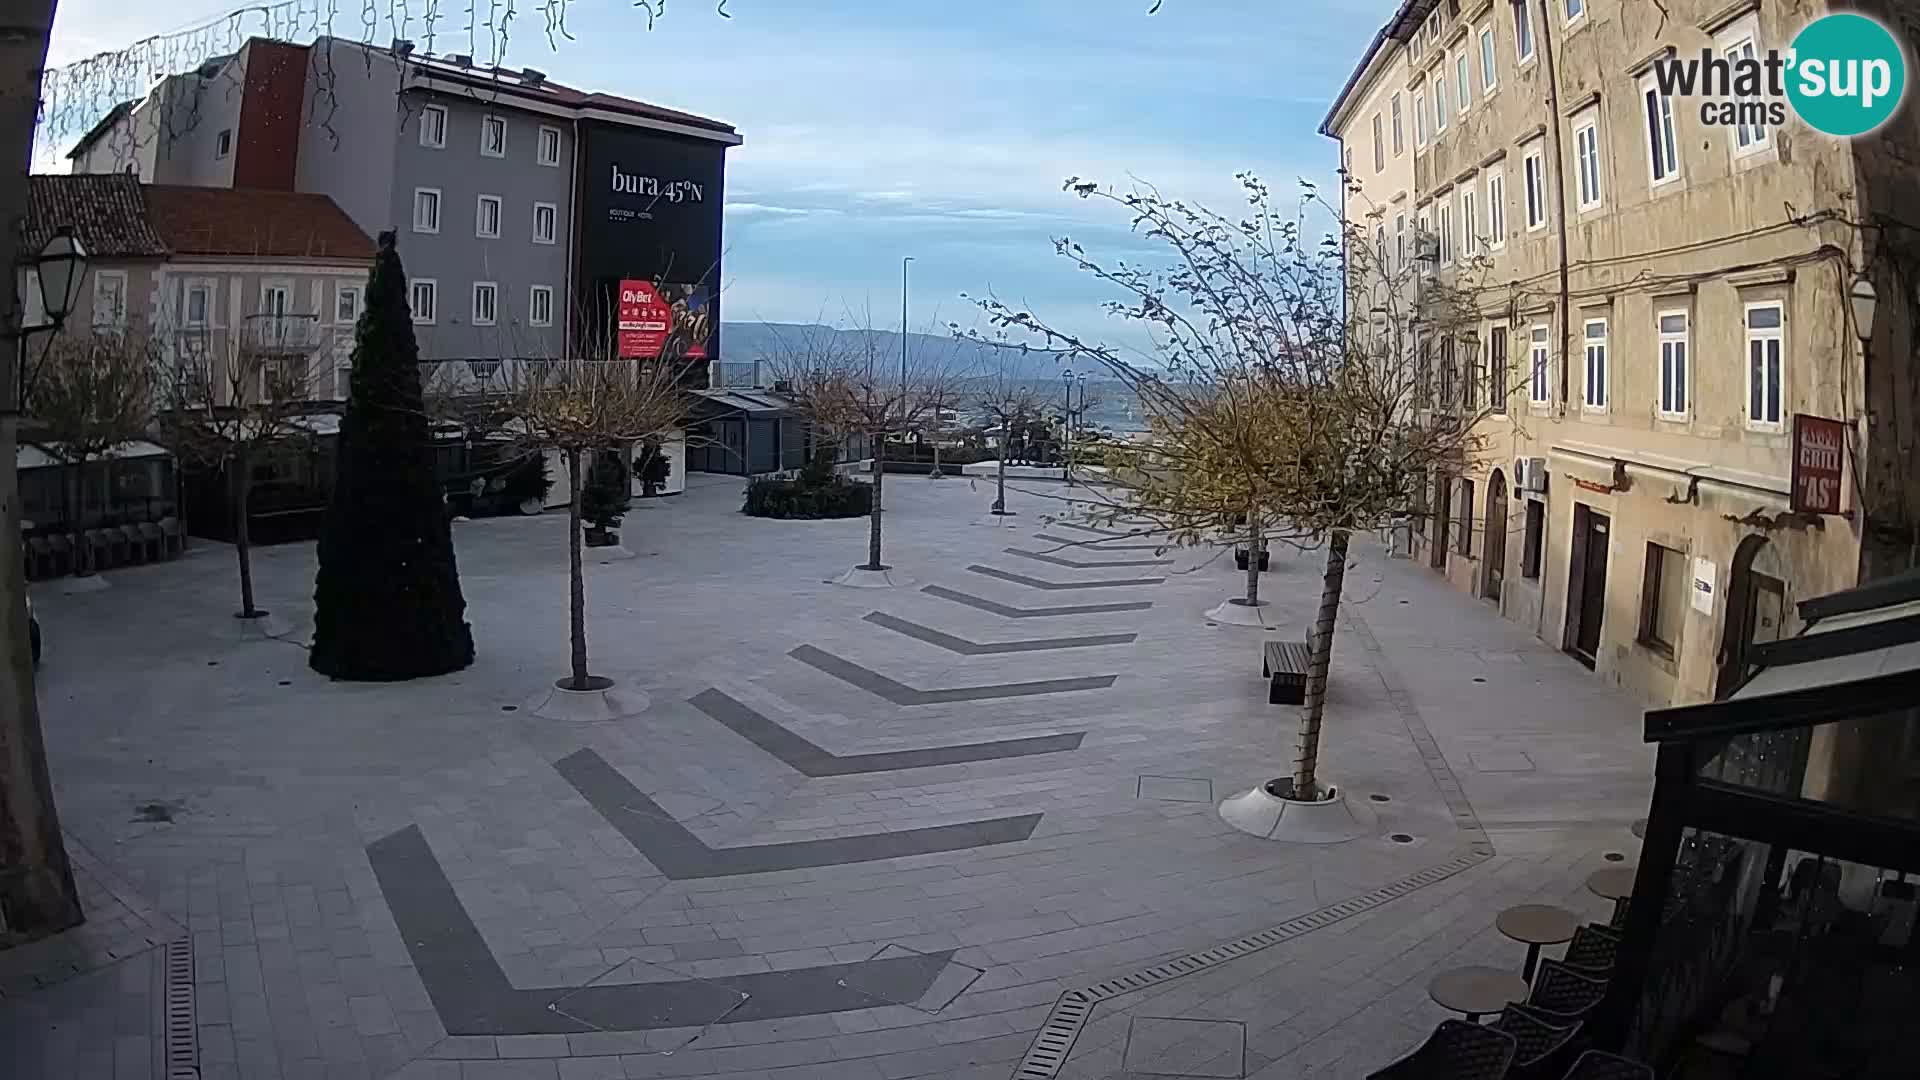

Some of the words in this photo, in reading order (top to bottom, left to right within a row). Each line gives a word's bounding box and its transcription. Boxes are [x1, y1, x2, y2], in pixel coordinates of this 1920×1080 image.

[612, 165, 658, 196] bura
[622, 290, 652, 304] OlyBet
[1800, 447, 1839, 472] GRILL
